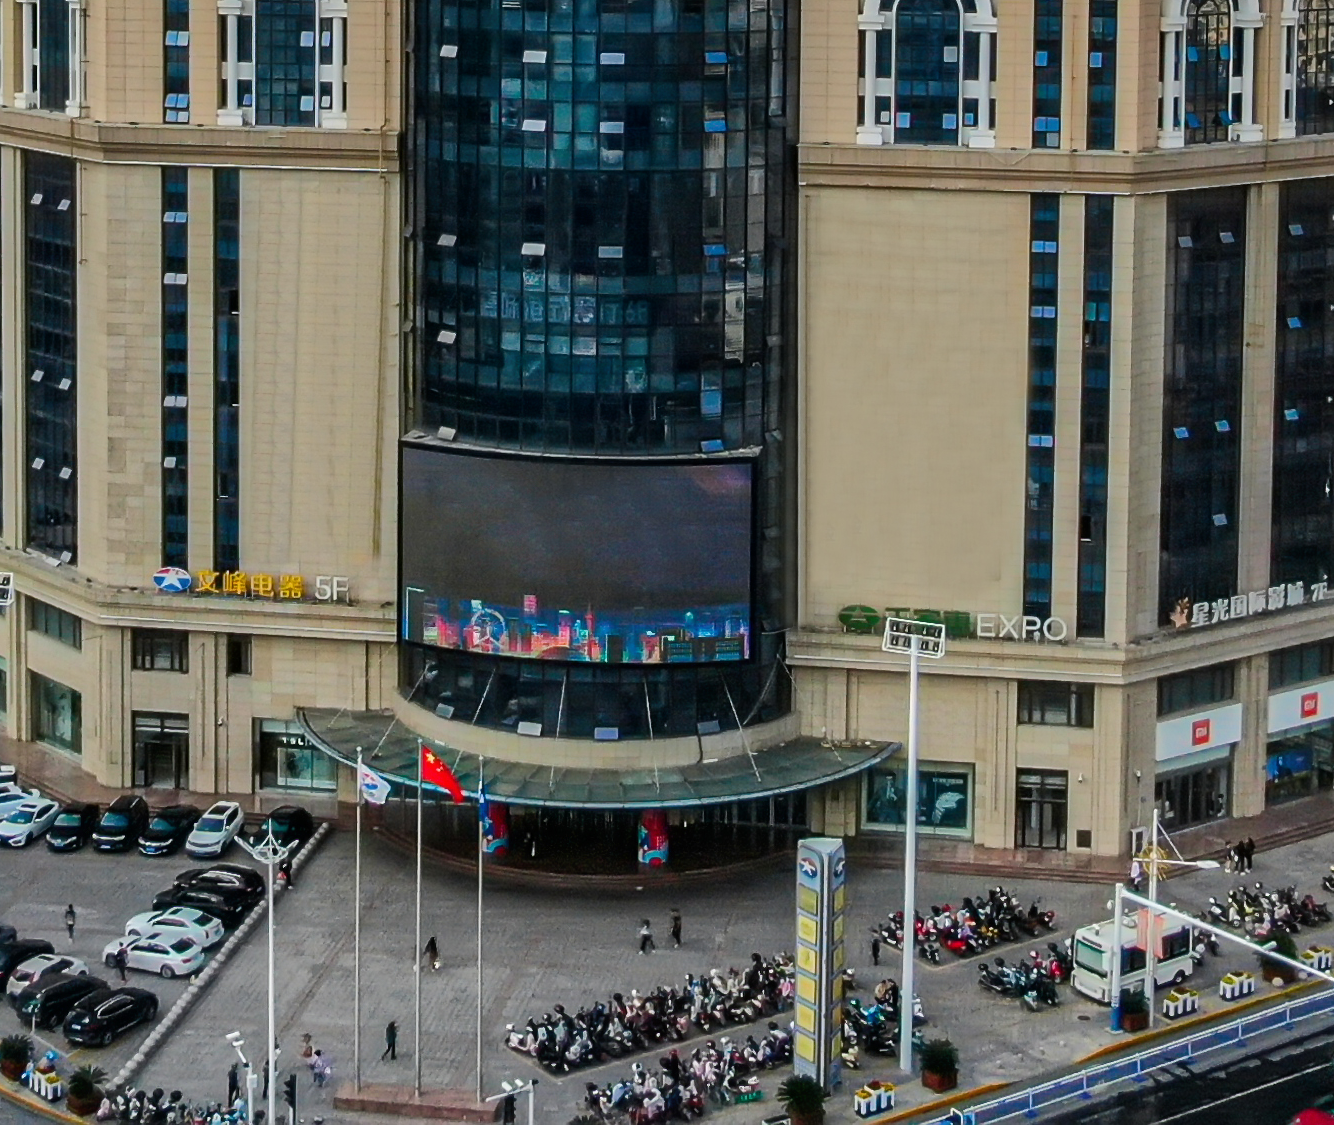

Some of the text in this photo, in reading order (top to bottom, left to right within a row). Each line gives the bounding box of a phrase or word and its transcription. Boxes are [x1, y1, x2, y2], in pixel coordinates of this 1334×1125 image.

[195, 569, 350, 602] 文峰电器 5F
[1190, 581, 1305, 628] 星光国际影城
[976, 613, 1068, 641] EXPO
